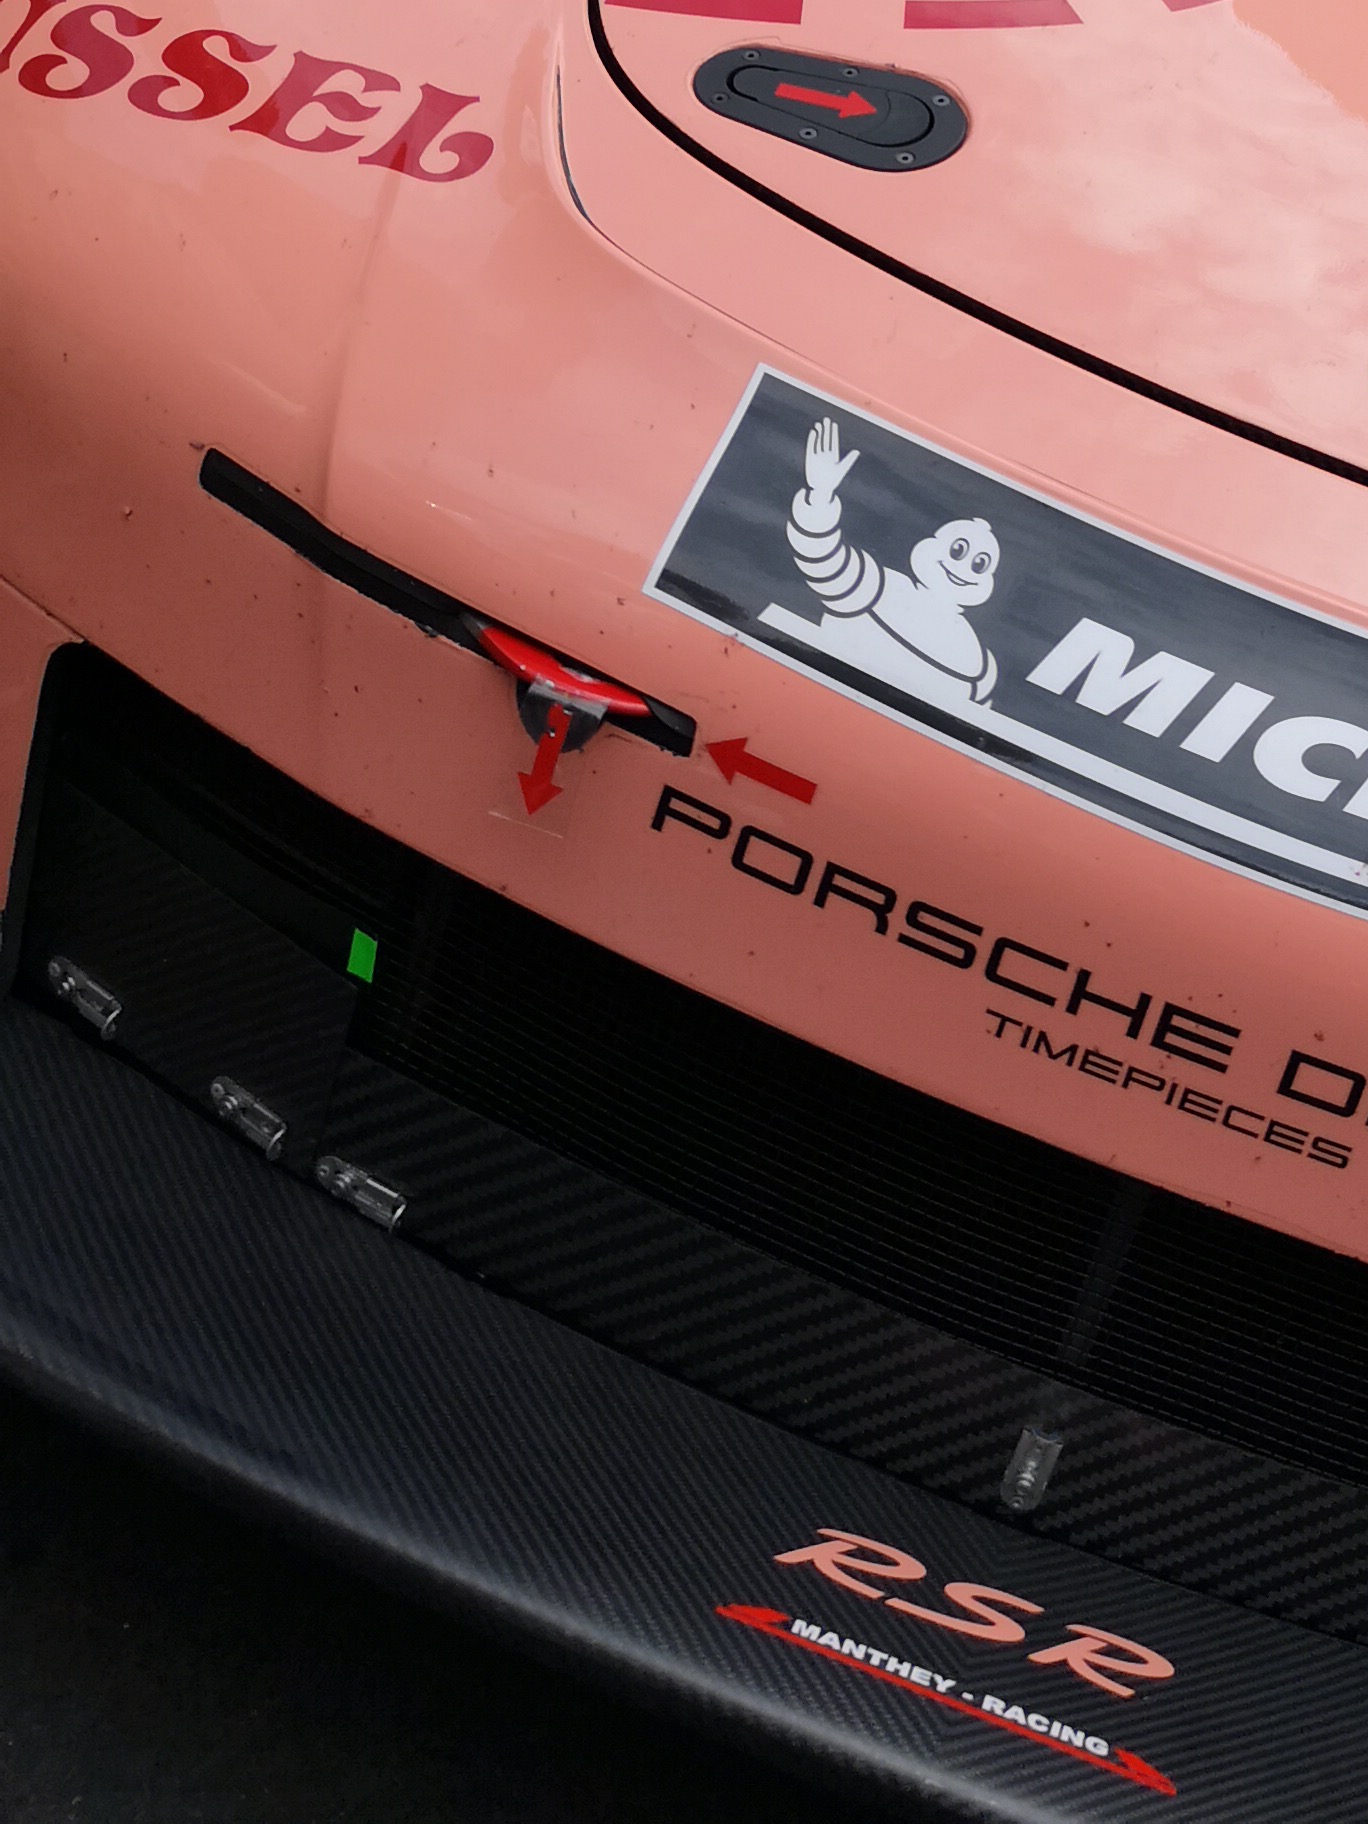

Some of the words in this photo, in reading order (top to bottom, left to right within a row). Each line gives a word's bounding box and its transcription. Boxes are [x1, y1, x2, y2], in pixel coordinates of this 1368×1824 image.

[650, 784, 1241, 1074] PORSCHE
[984, 1008, 1353, 1170] TIMEPIECES
[772, 1527, 1175, 1699] RSR
[789, 1618, 955, 1694] MANTHEY
[981, 1694, 1112, 1758] RACING
